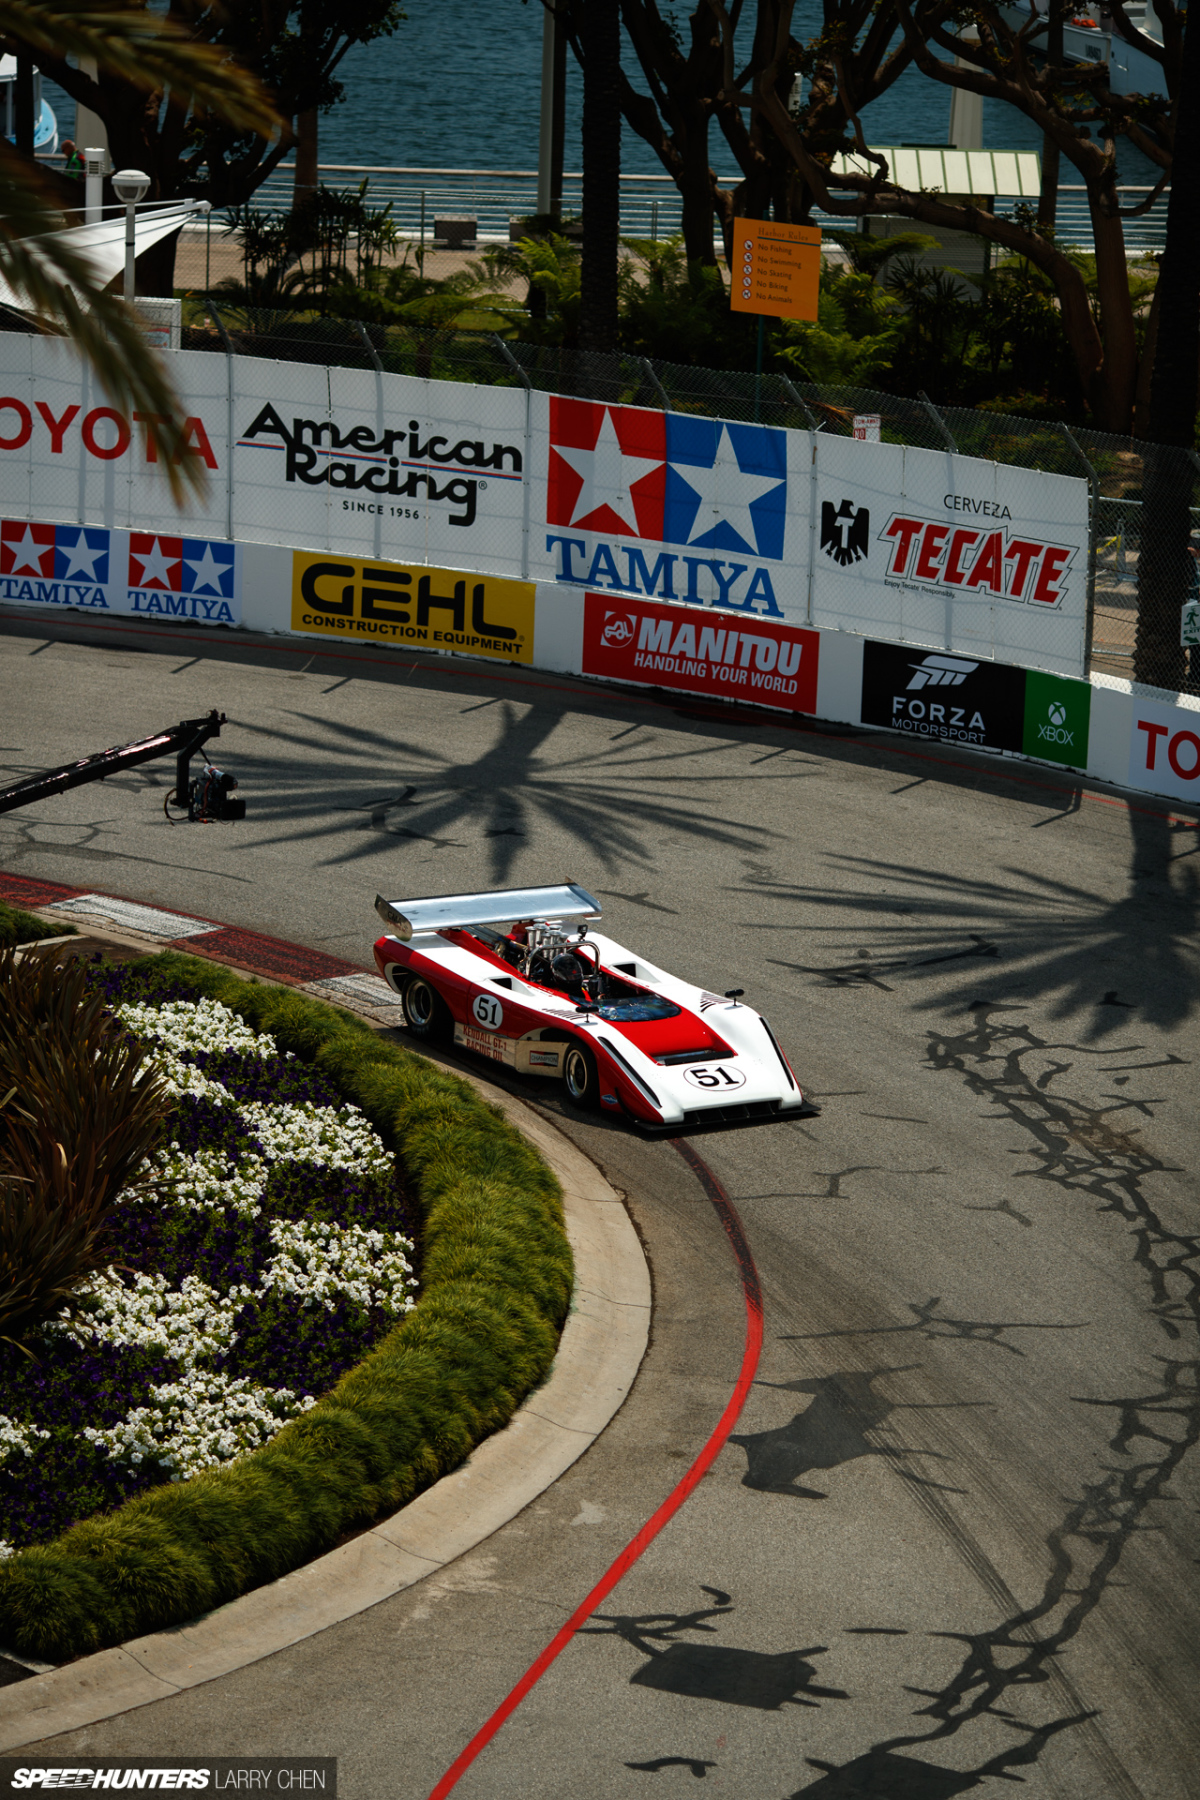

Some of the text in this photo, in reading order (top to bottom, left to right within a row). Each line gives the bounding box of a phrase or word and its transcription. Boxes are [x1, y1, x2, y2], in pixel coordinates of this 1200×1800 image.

[757, 227, 809, 241] Harbor Rules
[757, 256, 802, 269] No Swimming
[758, 243, 792, 255] No Fishing
[756, 280, 788, 292] No Biking
[757, 268, 792, 280] No Skating
[756, 292, 792, 303] No Animals
[242, 401, 522, 472] American
[855, 429, 865, 439] NO
[286, 443, 477, 527] Racing
[342, 500, 420, 520] SINCE 1956
[943, 494, 1012, 521] CERVEZA
[884, 516, 1072, 604] TECATE
[546, 534, 785, 618] TAMIYA
[884, 578, 901, 588] Enjoy
[0, 577, 110, 608] TAMIYA
[301, 562, 518, 640] GEHL
[127, 590, 235, 623] TAMIYA
[302, 613, 523, 654] CONSTRUCTION EQUIPMENT
[637, 616, 803, 676] MANITOU
[634, 652, 798, 695] HANDLING YOUR WORLD
[892, 696, 985, 731] FORZA
[891, 716, 986, 744] MOTORSPORT
[1037, 723, 1074, 747] XBOX
[476, 996, 498, 1027] 51
[463, 1024, 507, 1052] KENDALL GT-1
[466, 1038, 504, 1063] RACING OIL
[531, 1054, 558, 1064] CHAMPION
[689, 1066, 740, 1087] 51
